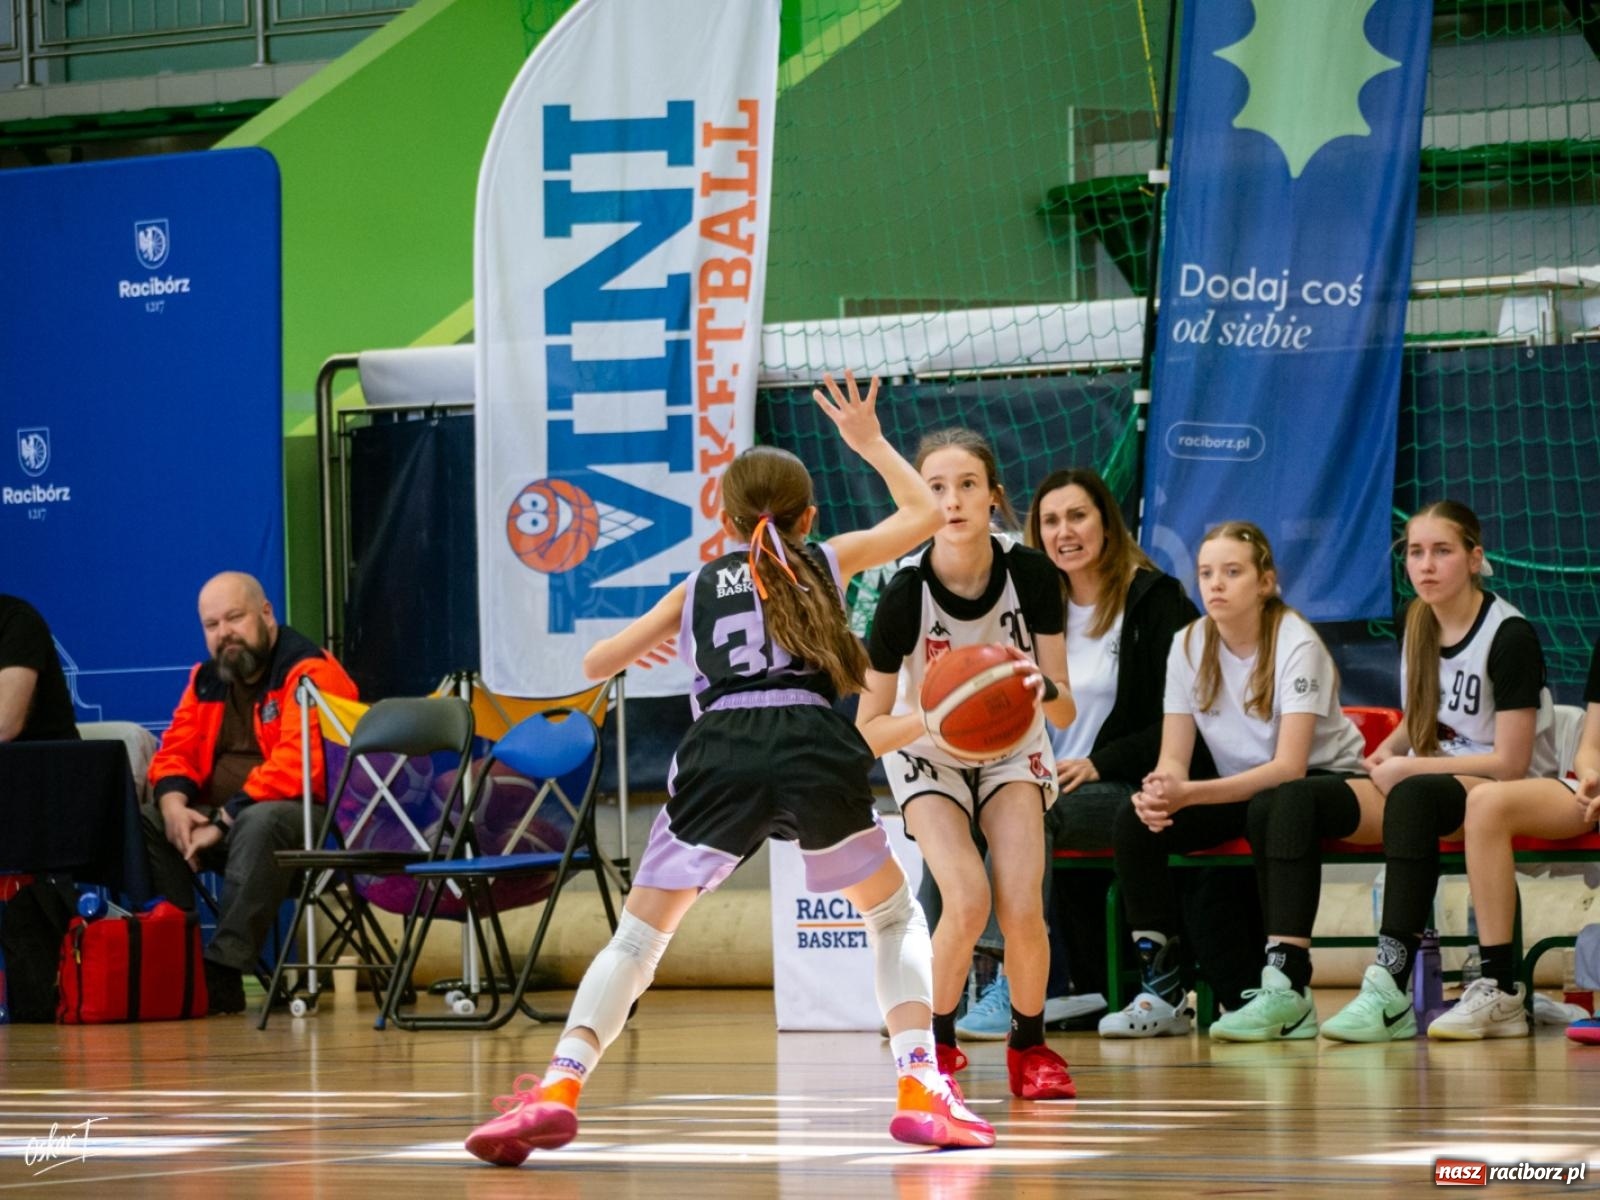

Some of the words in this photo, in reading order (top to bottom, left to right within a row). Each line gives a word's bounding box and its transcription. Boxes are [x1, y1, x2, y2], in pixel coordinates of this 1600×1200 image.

[118, 275, 191, 298] Racibórz
[1179, 263, 1289, 312] Dodaj
[1301, 274, 1364, 307] coś
[697, 98, 759, 563] ASKETBALL
[1172, 309, 1216, 344] od
[1218, 312, 1312, 350] siebie
[543, 100, 694, 633] MINI
[1178, 433, 1250, 452] raciborz.pl
[2, 483, 71, 504] Racibórz
[717, 582, 753, 599] BASK
[1448, 670, 1481, 716] 99
[796, 898, 864, 920] RACI
